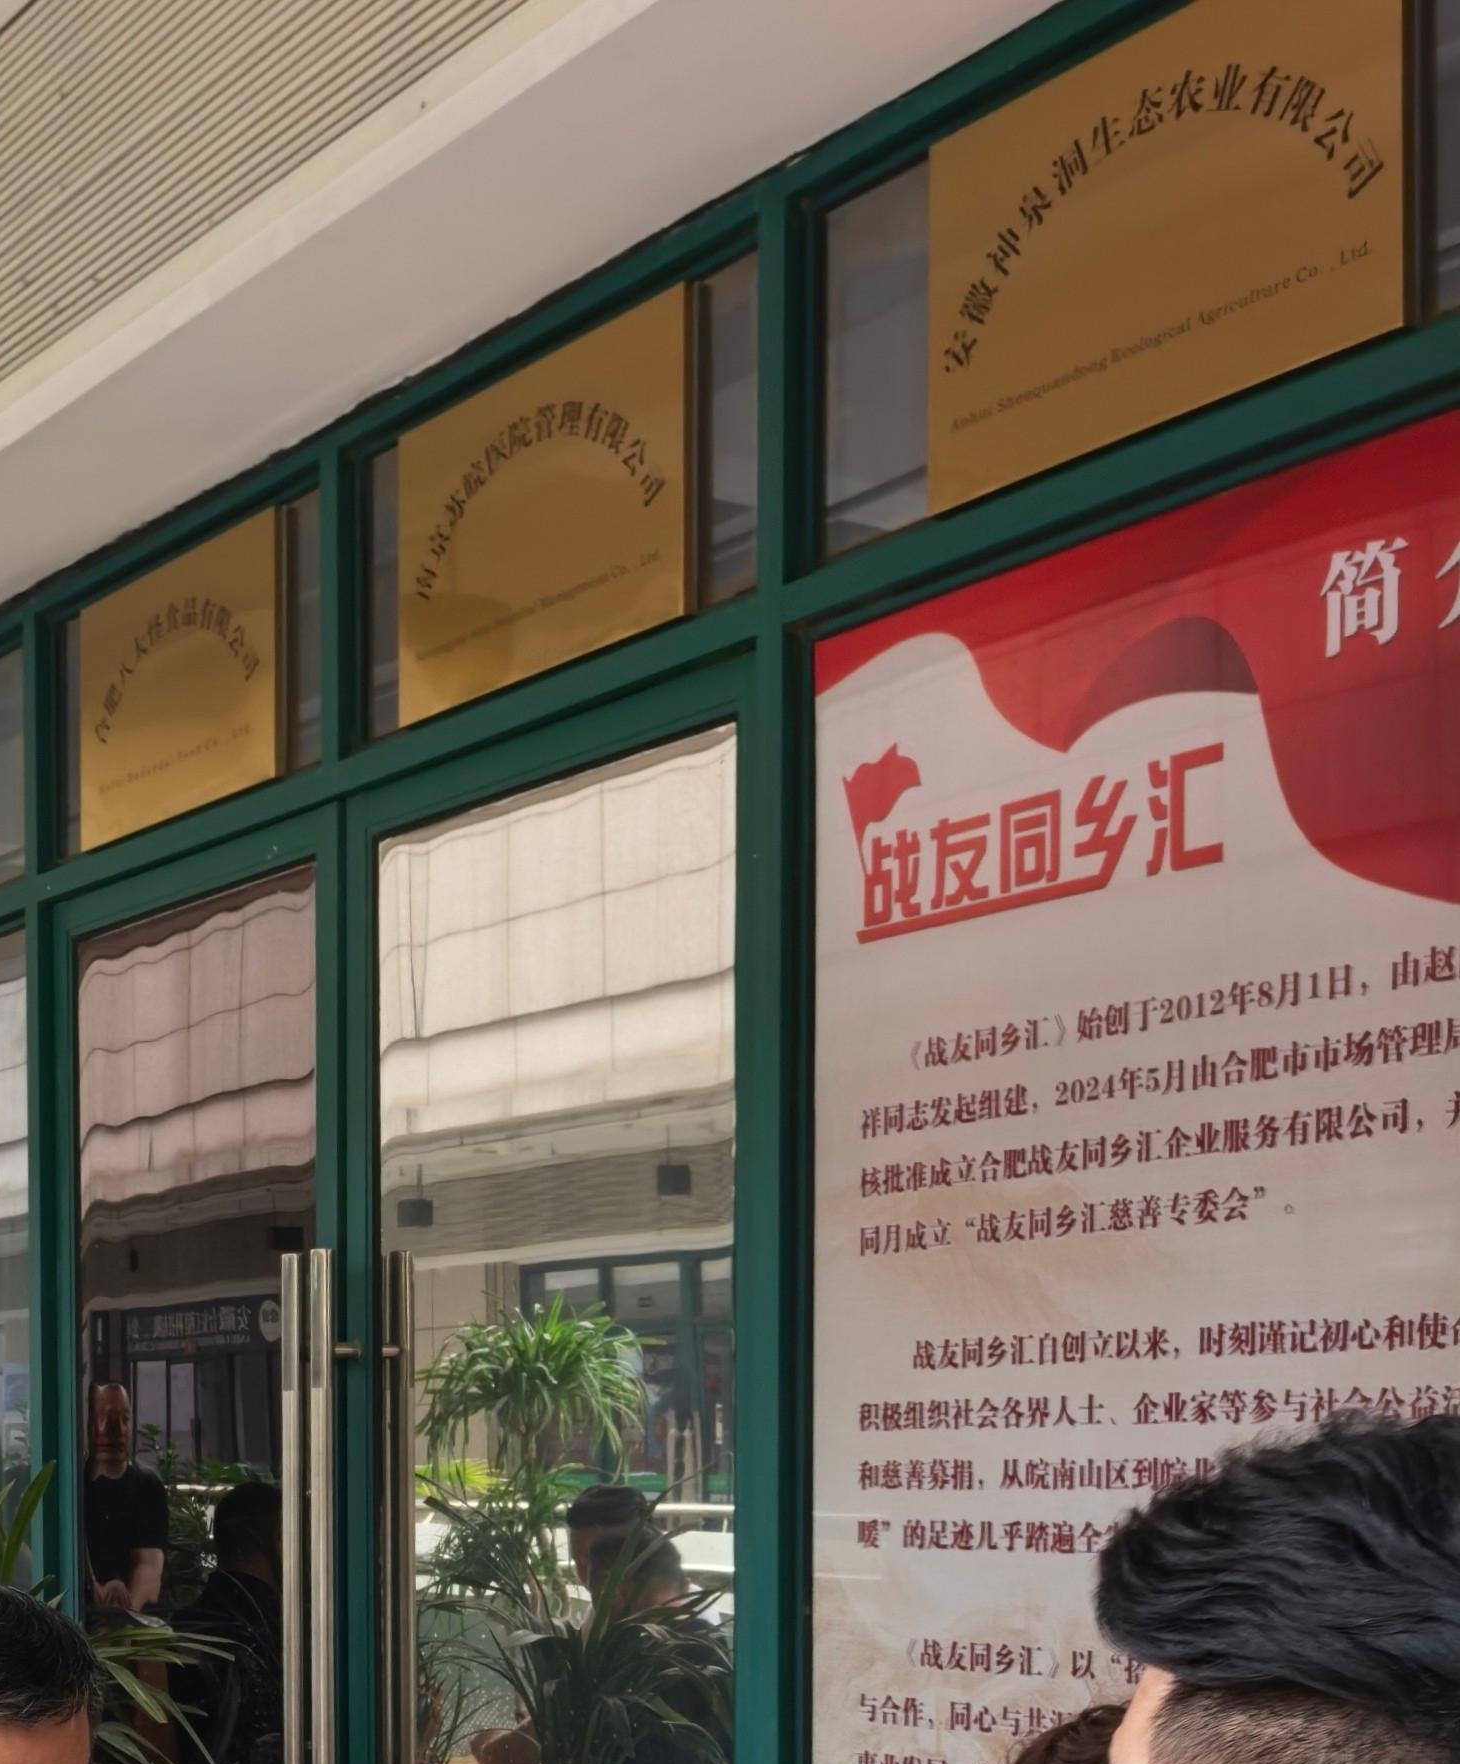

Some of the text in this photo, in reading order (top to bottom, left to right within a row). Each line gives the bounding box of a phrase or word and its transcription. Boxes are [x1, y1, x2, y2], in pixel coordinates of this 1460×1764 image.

[862, 741, 1224, 928] 战友同乡汇
[910, 946, 1460, 1069] 《战友同乡汇》始创于2012年8月1日，由赵
[913, 1312, 1460, 1370] 战友同乡汇自创立以来，时刻谨记初心和使
[857, 1520, 1120, 1554] 暖”的足迹几乎踏遍全
